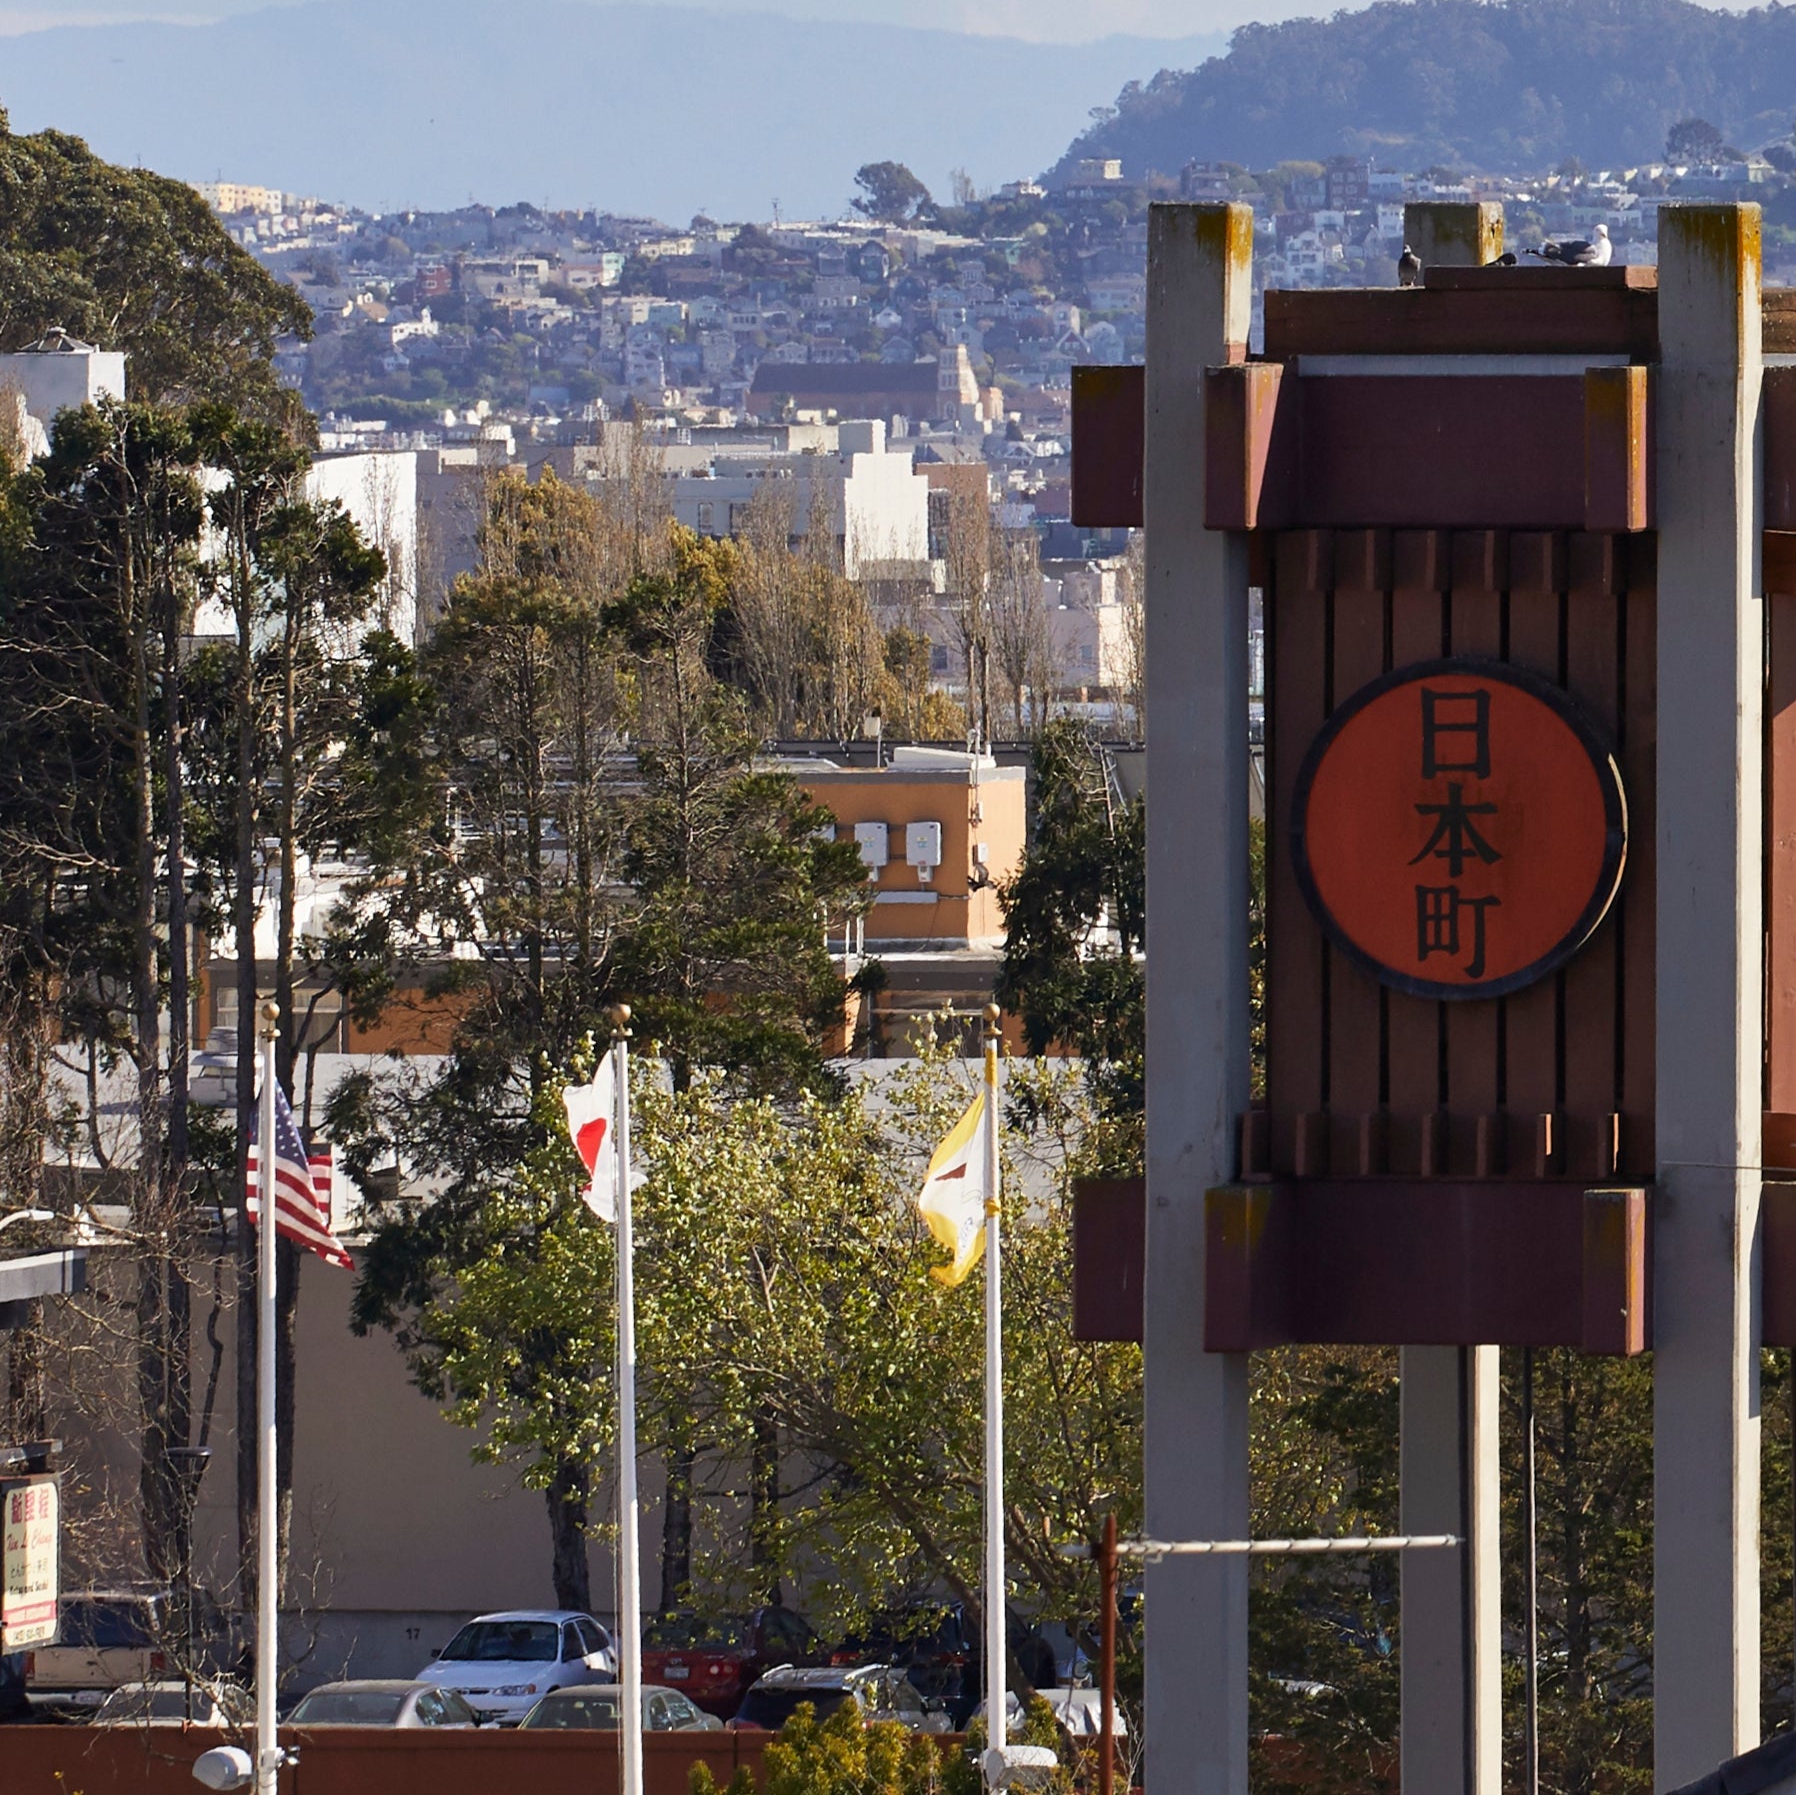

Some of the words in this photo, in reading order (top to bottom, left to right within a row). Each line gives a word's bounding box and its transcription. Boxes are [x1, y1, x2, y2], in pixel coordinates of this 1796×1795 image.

[1407, 686, 1503, 979] 日本町
[405, 1628, 421, 1640] 17
